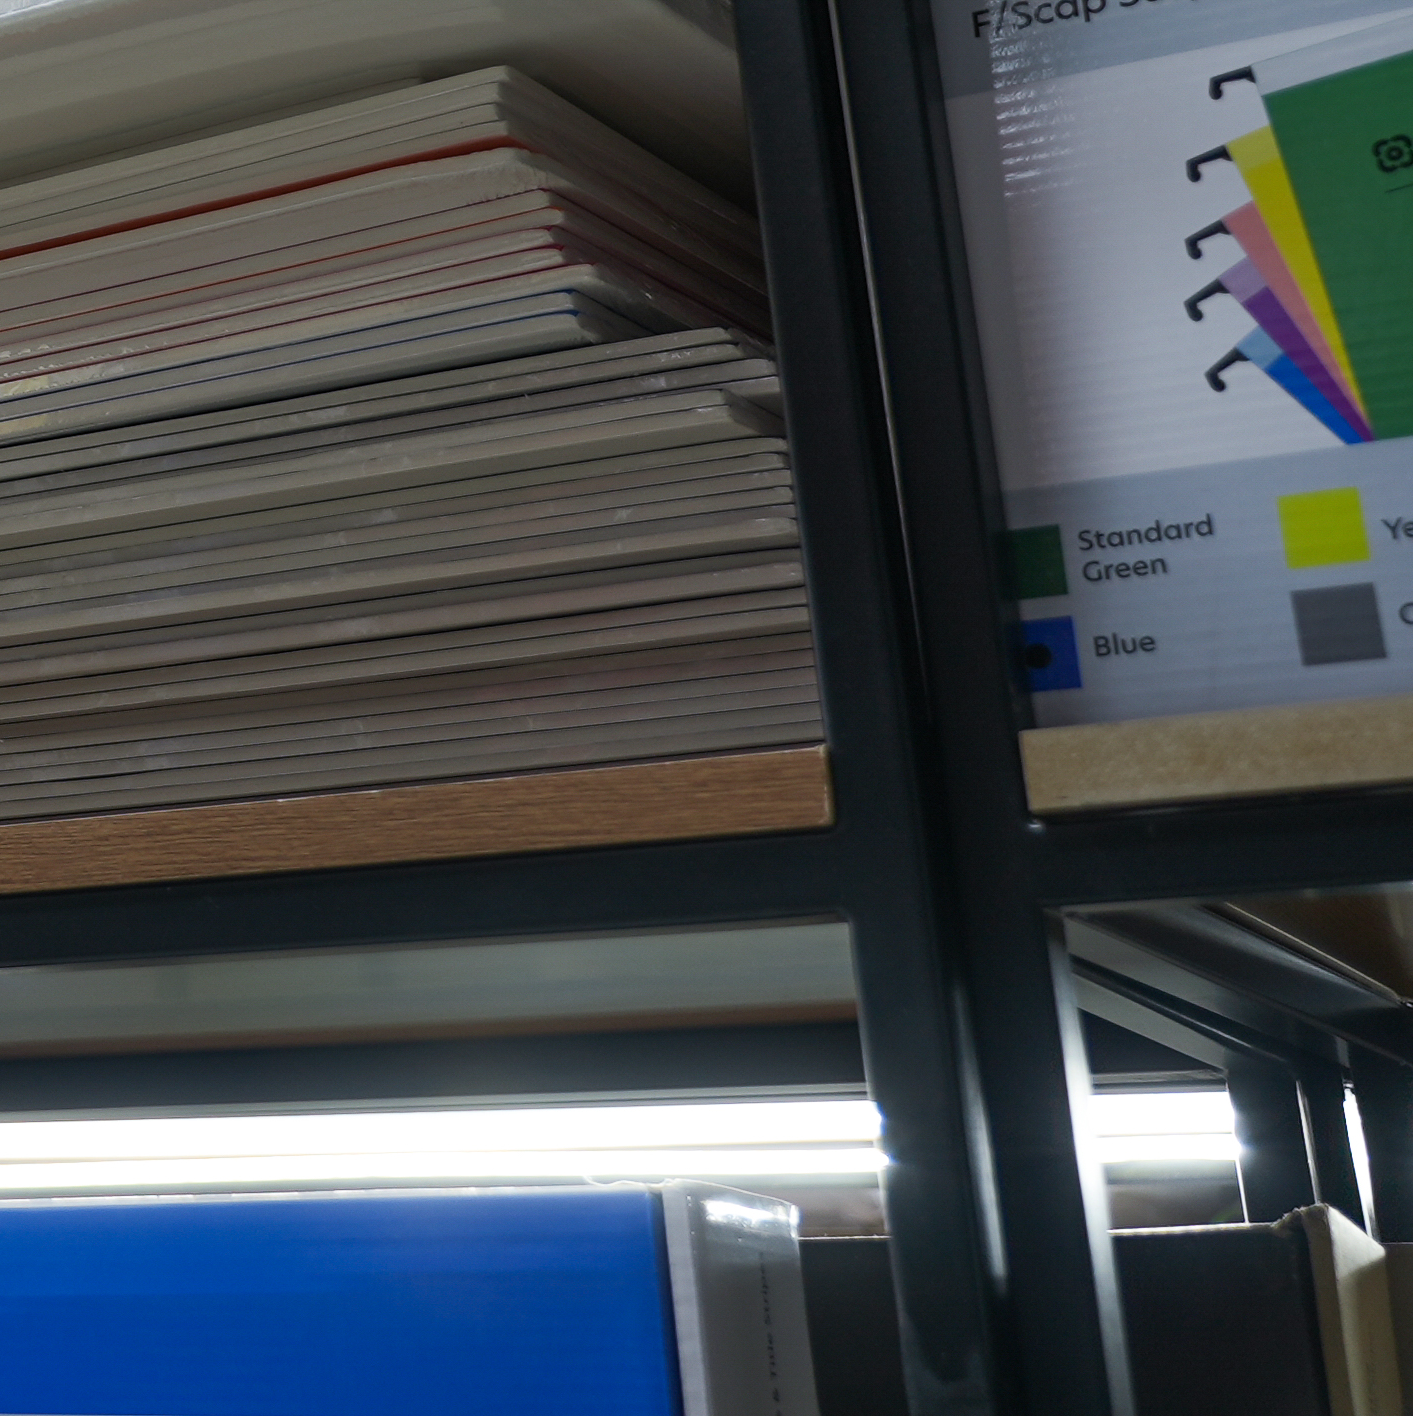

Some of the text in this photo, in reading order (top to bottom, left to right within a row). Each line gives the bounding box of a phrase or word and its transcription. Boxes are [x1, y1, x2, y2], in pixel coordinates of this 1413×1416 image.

[1077, 513, 1215, 552] Standard
[1081, 555, 1170, 584] Green
[1092, 630, 1159, 658] Blue
